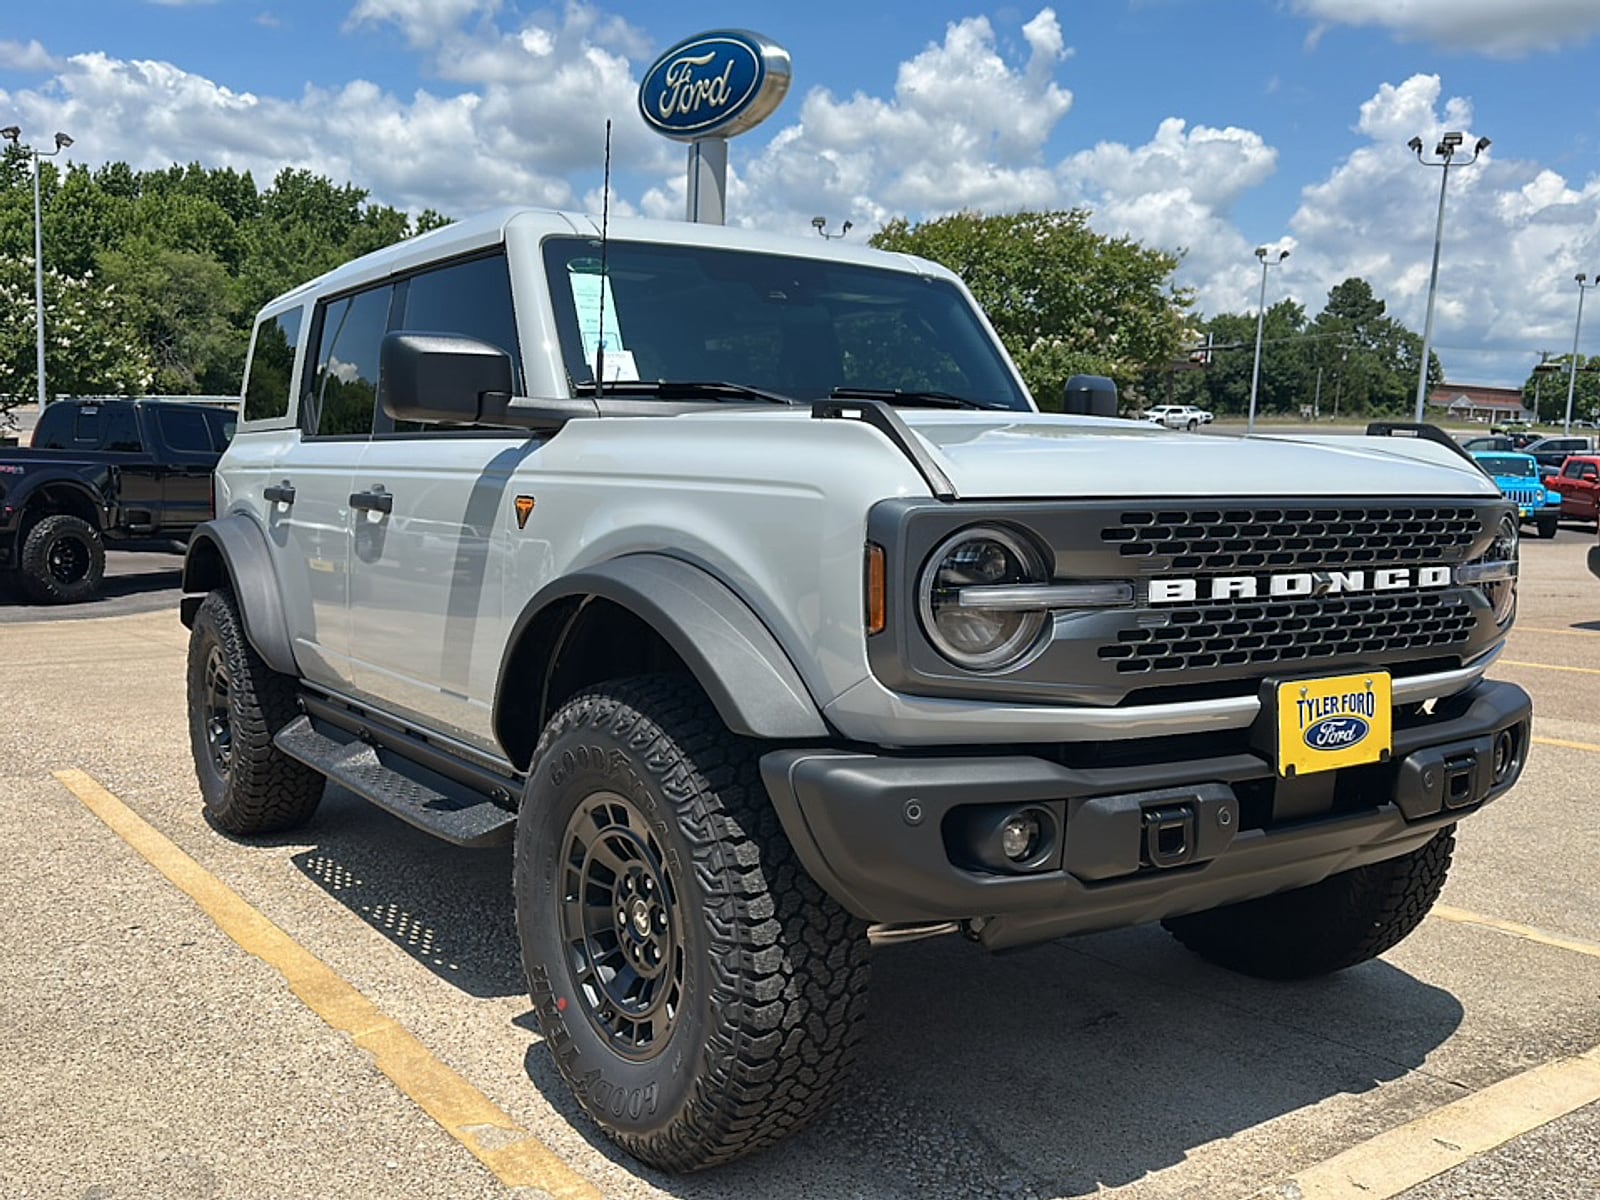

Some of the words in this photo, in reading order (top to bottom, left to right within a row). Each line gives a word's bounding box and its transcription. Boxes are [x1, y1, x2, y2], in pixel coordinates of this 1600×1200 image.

[659, 51, 735, 119] Ford
[1149, 566, 1451, 602] BRONCO
[1296, 695, 1340, 730] TYLER
[1341, 691, 1375, 718] FORD
[1316, 720, 1357, 745] Ford
